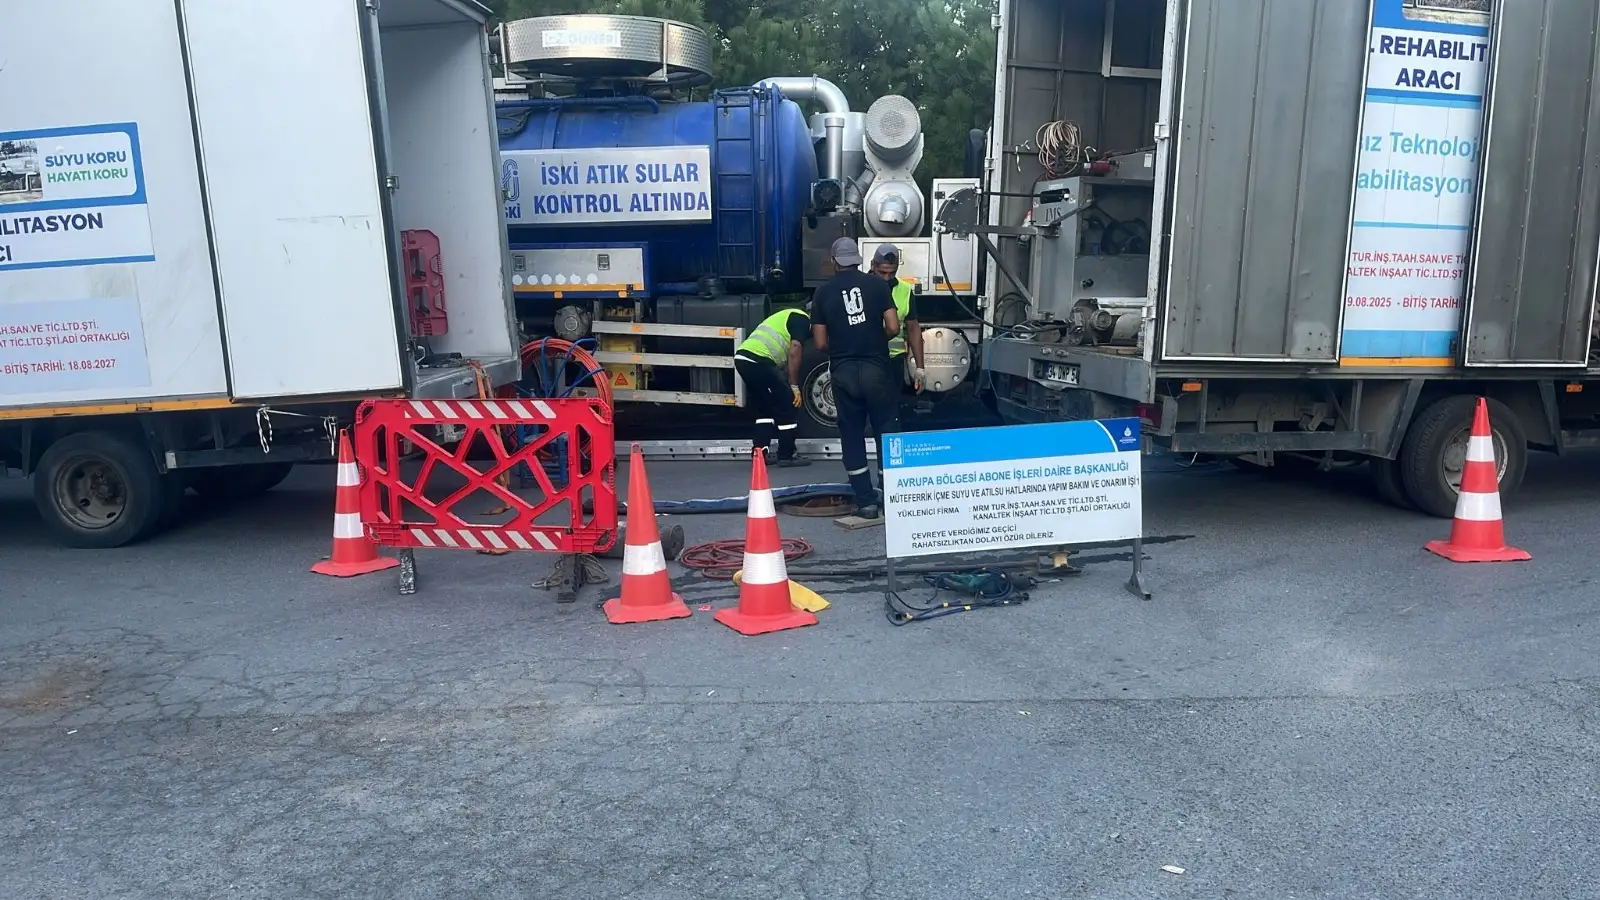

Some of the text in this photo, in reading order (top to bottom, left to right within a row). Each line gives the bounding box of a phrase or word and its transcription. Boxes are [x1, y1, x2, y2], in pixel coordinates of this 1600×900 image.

[1395, 68, 1461, 90] ARACI
[1389, 132, 1478, 163] Teknoloj
[45, 151, 127, 168] SUYU KORU
[47, 168, 128, 183] HAYATI KORU
[541, 161, 699, 185] İSKİ ATIK SULAR
[534, 192, 710, 215] KONTROL ALTINDA
[1402, 295, 1427, 311] BİTİŞ
[80, 331, 130, 343] ORTAKLIĞI
[4, 360, 29, 375] BİTİŞ
[31, 359, 66, 372] TARİHİ:
[68, 359, 116, 371] 18.08.2027
[897, 460, 1129, 488] AVRUPA BÖLGESİ ABONE İŞLERİ DAİRE BAŞKANLIĞI
[889, 490, 933, 504] MÜTEFERRİK
[933, 489, 950, 502] İÇME
[951, 489, 970, 500] SUYU
[971, 488, 980, 498] VE
[1005, 483, 1047, 496] HATLARINDA
[1048, 481, 1068, 493] YAPIM
[1068, 480, 1090, 491] BAKIM
[1091, 480, 1100, 489] VE
[1101, 477, 1127, 488] ONARIM
[937, 506, 960, 515] FİRMA
[972, 504, 990, 512] MRM
[973, 511, 1011, 521] KANALTEK
[1012, 508, 1038, 519] İNŞAAT
[1093, 501, 1131, 512] ORTAKLIĞI
[911, 531, 946, 541] ÇEVREYE
[992, 524, 1017, 535] GEÇİCİ
[911, 531, 1054, 549] RAHATSIZLIKTAN DOLAYI ÖZÜR DİLERİZ
